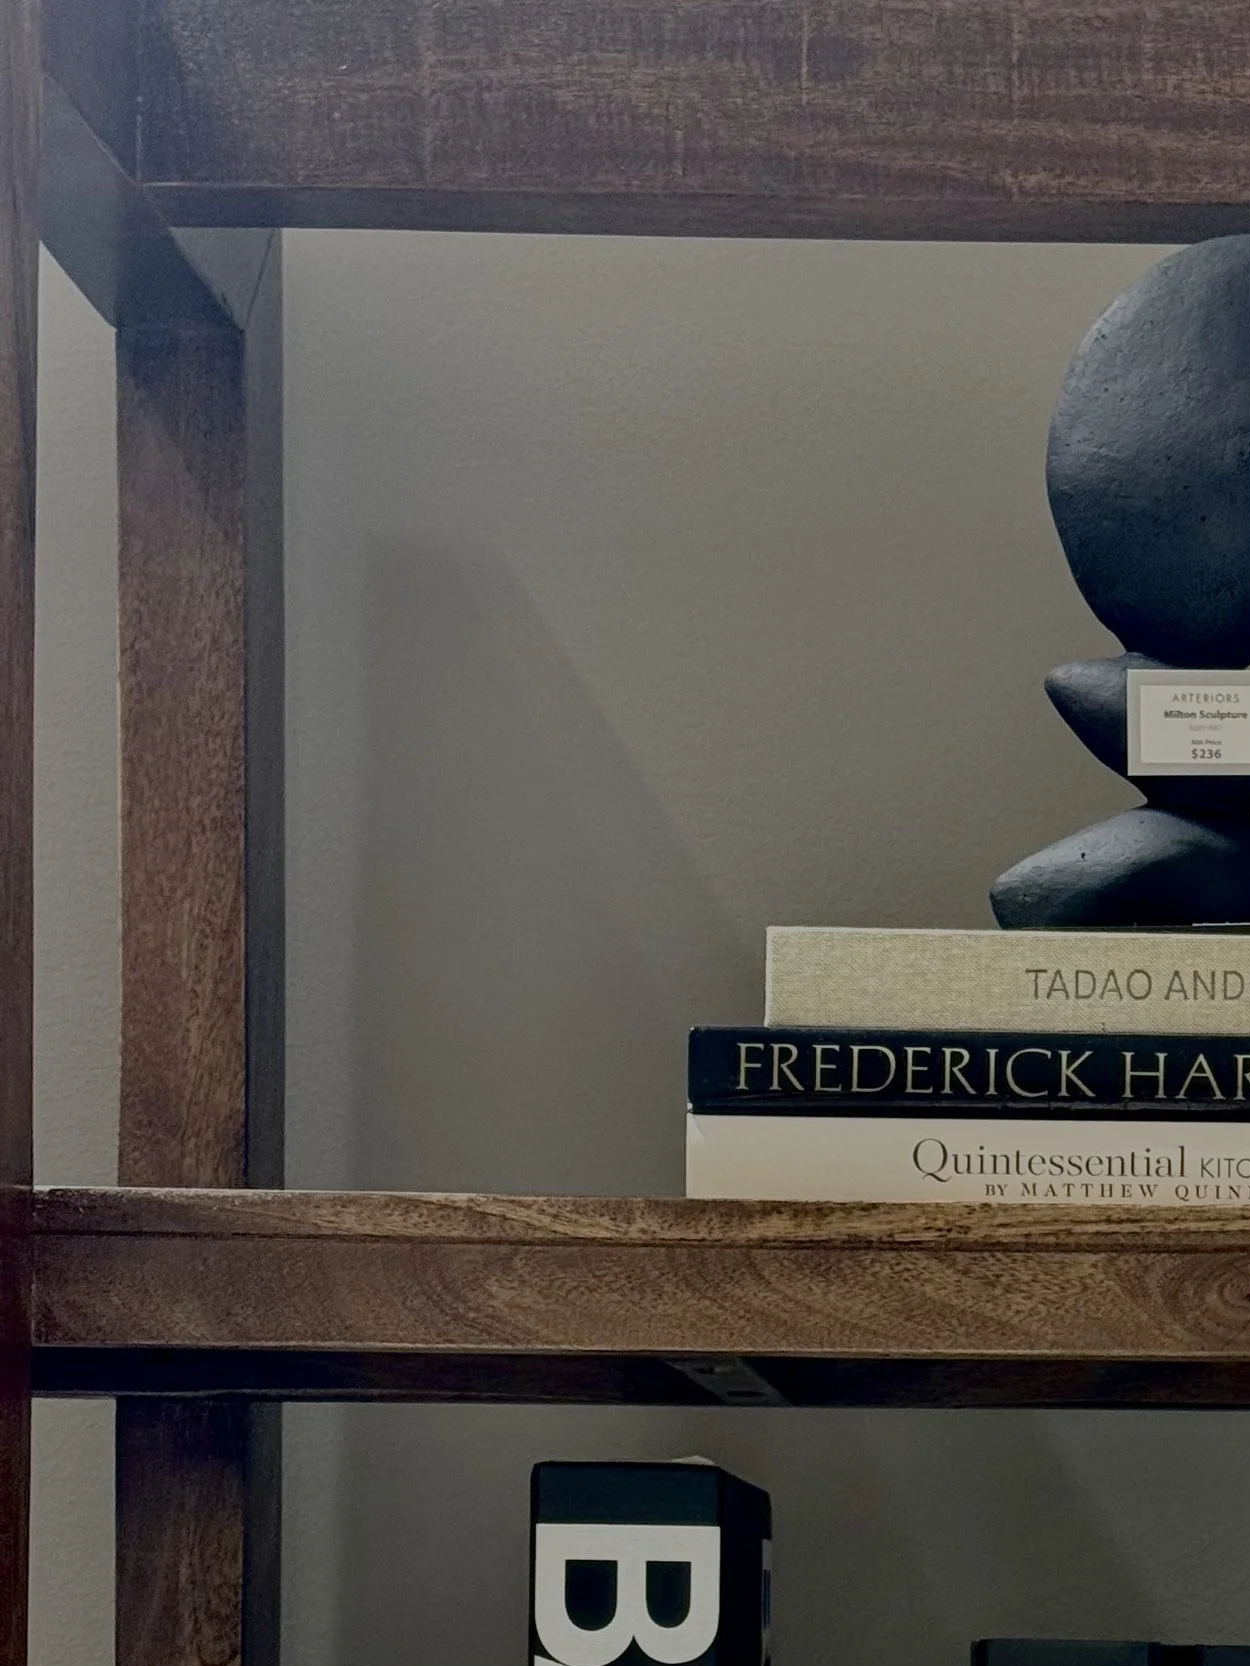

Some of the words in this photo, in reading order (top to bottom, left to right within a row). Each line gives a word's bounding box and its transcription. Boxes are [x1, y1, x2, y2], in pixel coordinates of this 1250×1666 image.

[1171, 693, 1240, 704] ARTERIORS
[1199, 710, 1248, 721] Sculpture
[1191, 748, 1222, 760] $236
[1025, 968, 1153, 1001] TADAO
[735, 1040, 1097, 1099] FREDERICK
[912, 1137, 1189, 1183] Quintessential
[984, 1183, 1008, 1197] BY
[1020, 1182, 1159, 1198] MATTHEW
